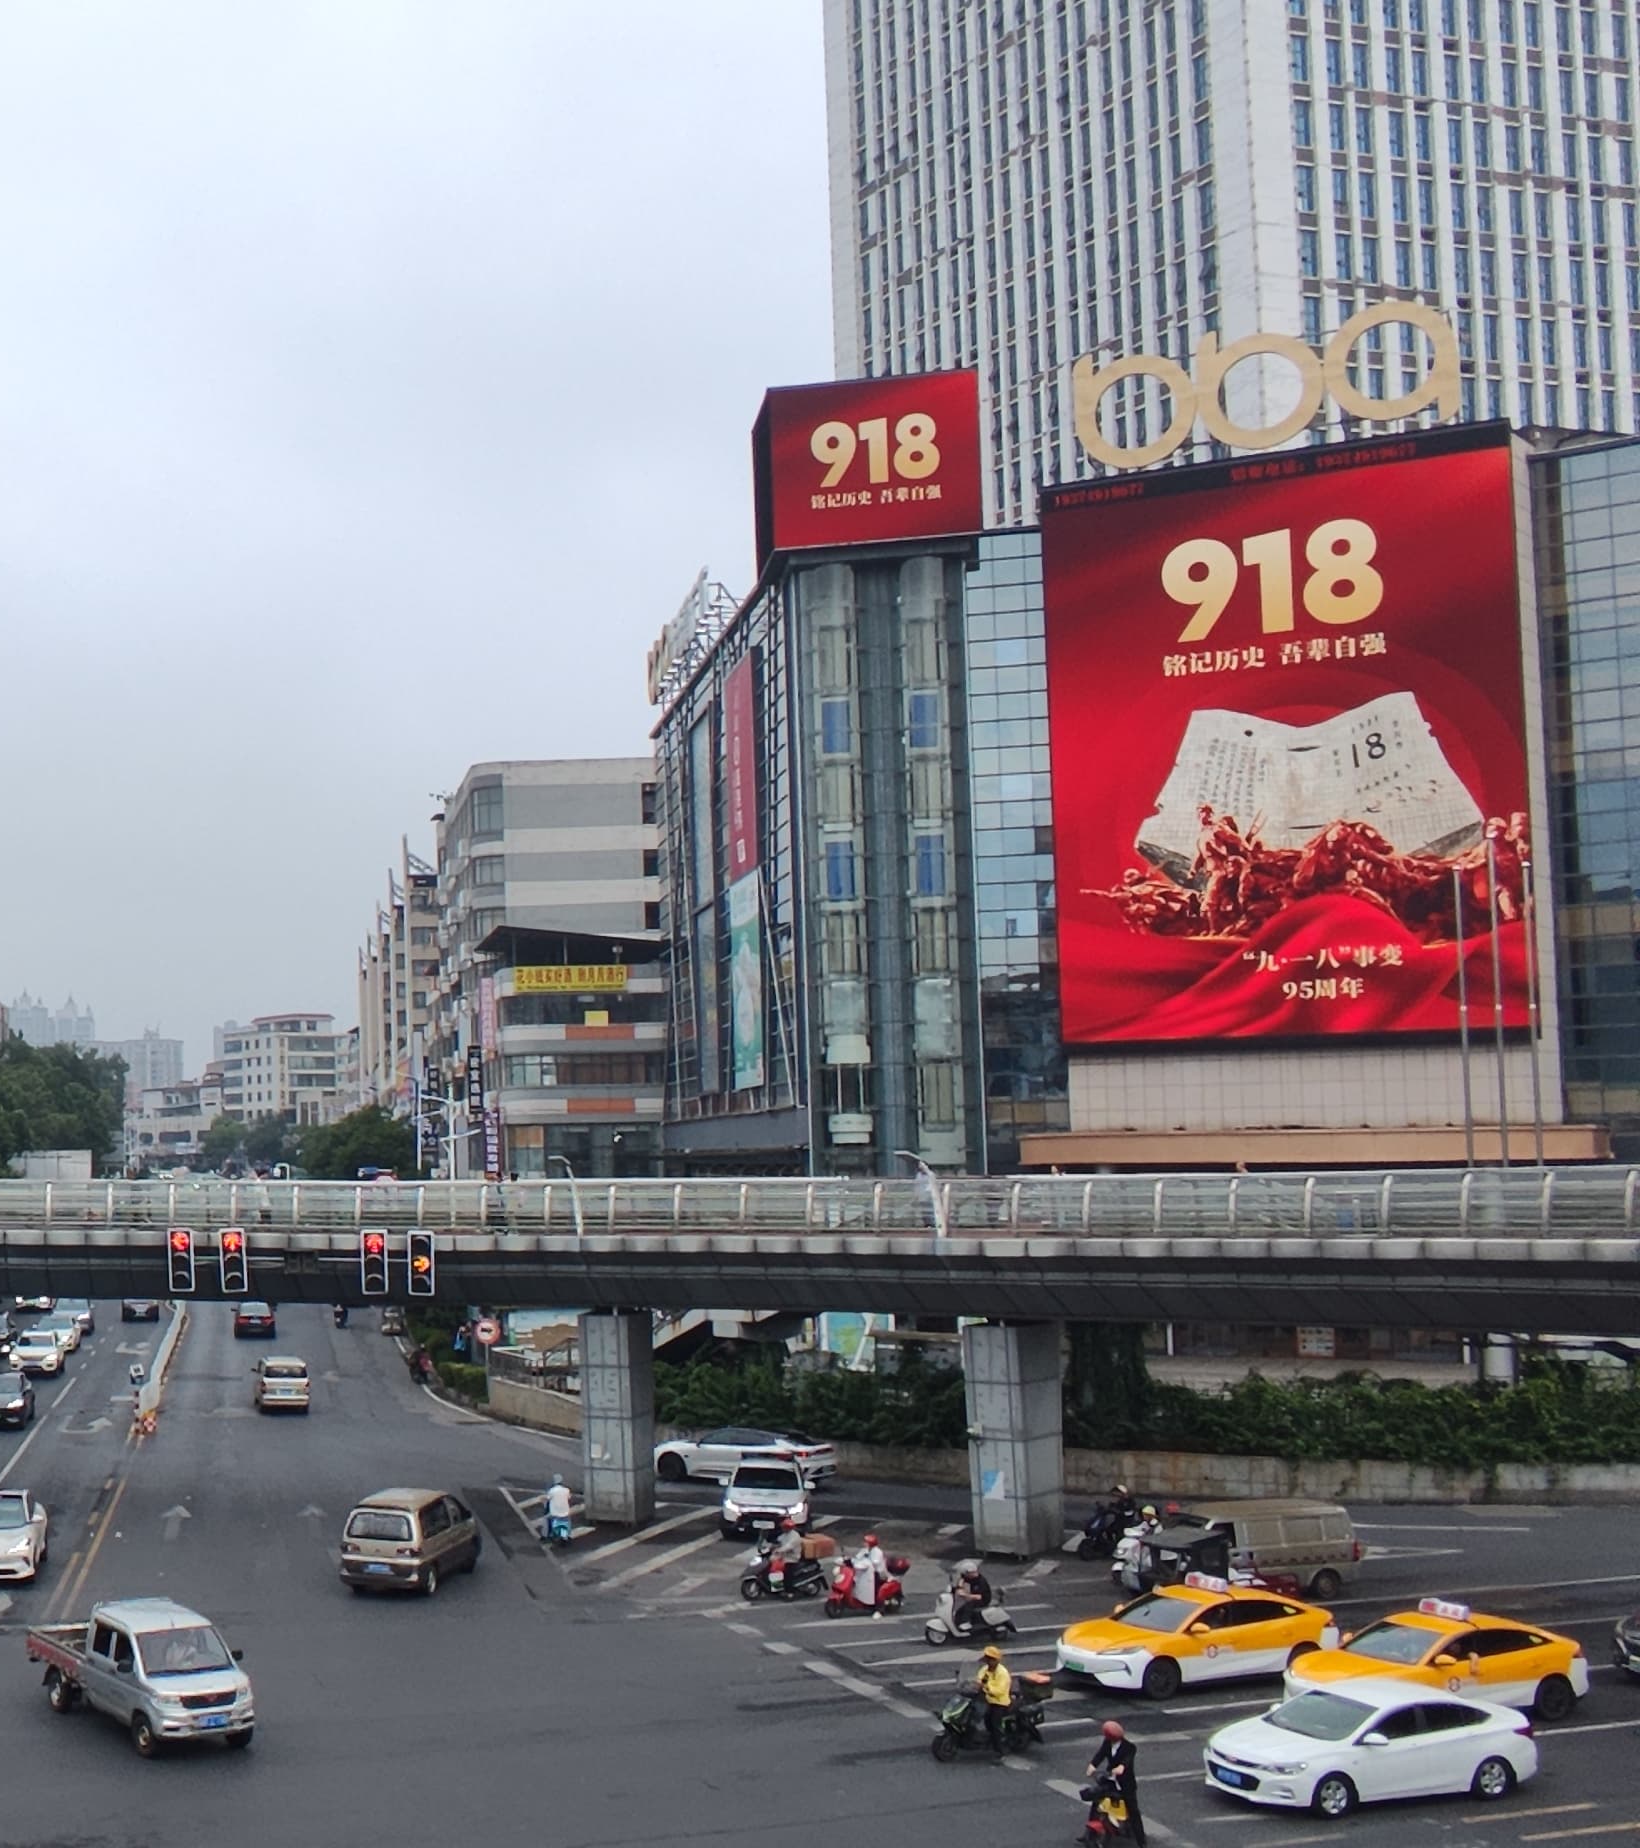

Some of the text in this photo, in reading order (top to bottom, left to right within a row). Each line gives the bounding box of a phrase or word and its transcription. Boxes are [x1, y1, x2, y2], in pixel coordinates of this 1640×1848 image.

[810, 412, 941, 488] 918
[811, 485, 943, 509] 铭记历史 吾辈自强
[1161, 518, 1384, 643] 918
[1163, 632, 1388, 677] 铭记历史 吾辈自强
[1351, 732, 1386, 768] 18
[1282, 977, 1365, 1000] 95周年
